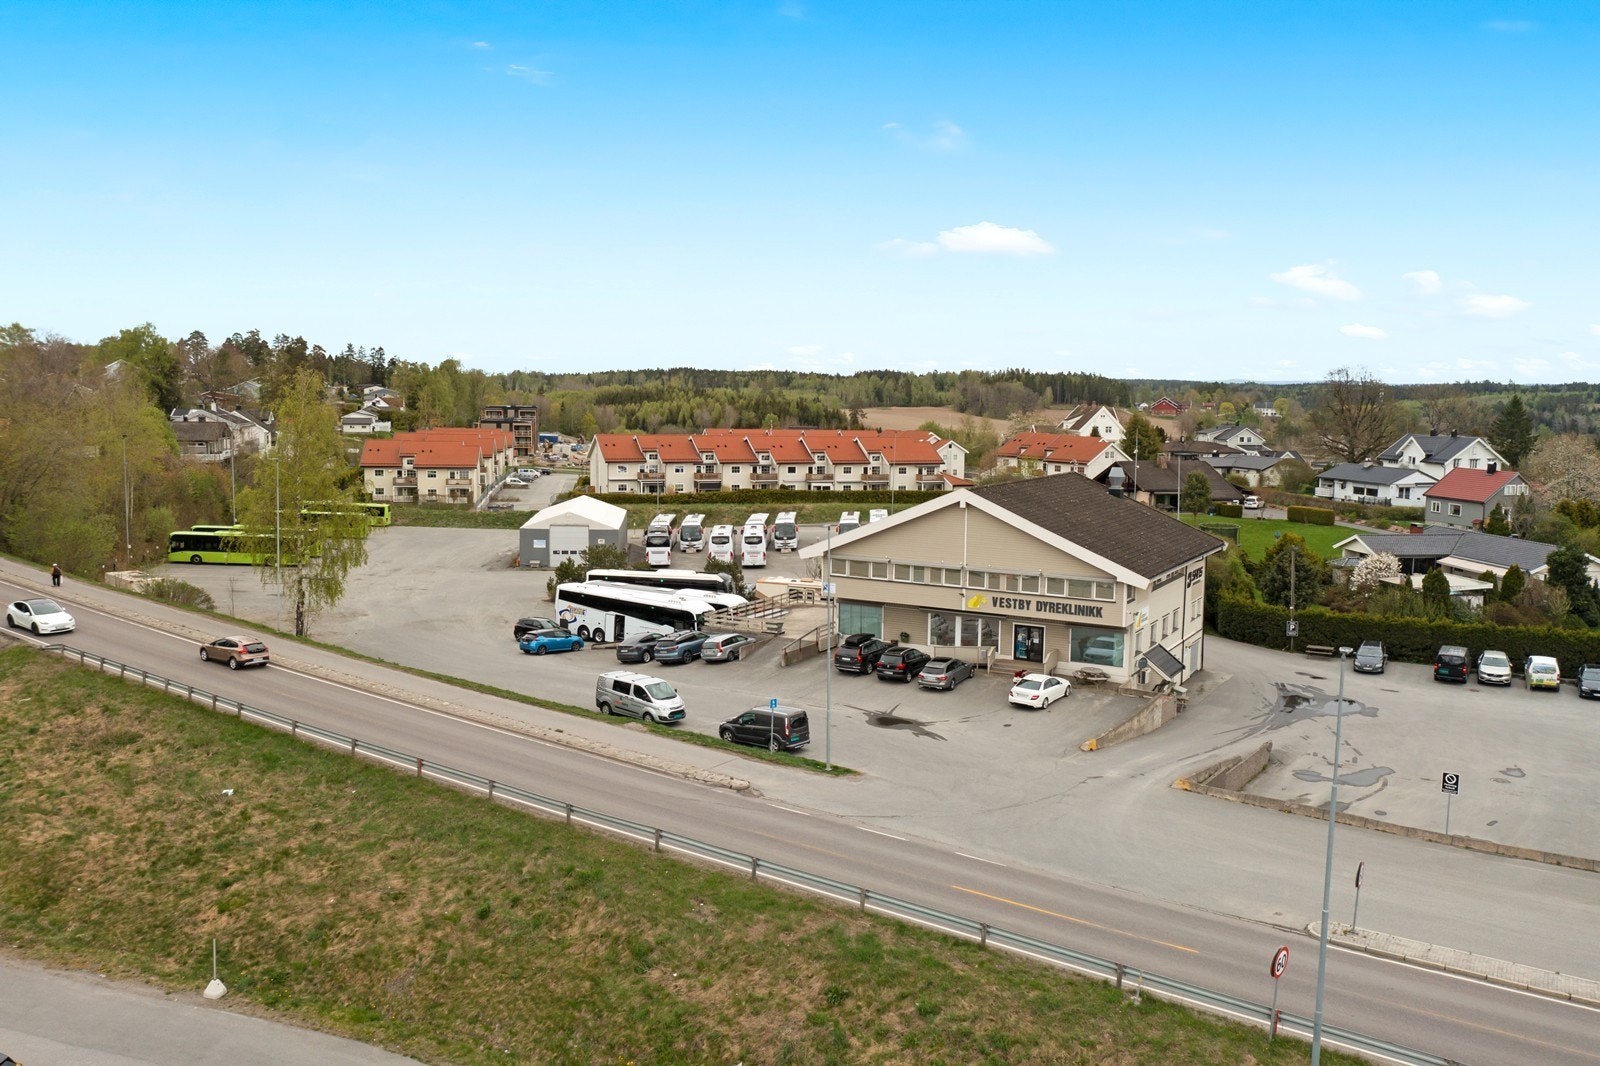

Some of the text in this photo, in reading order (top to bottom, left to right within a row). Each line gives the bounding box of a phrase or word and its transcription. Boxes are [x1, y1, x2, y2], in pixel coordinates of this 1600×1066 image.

[992, 596, 1103, 618] VESTBY DYREKLINIKK
[1277, 954, 1286, 972] 60
